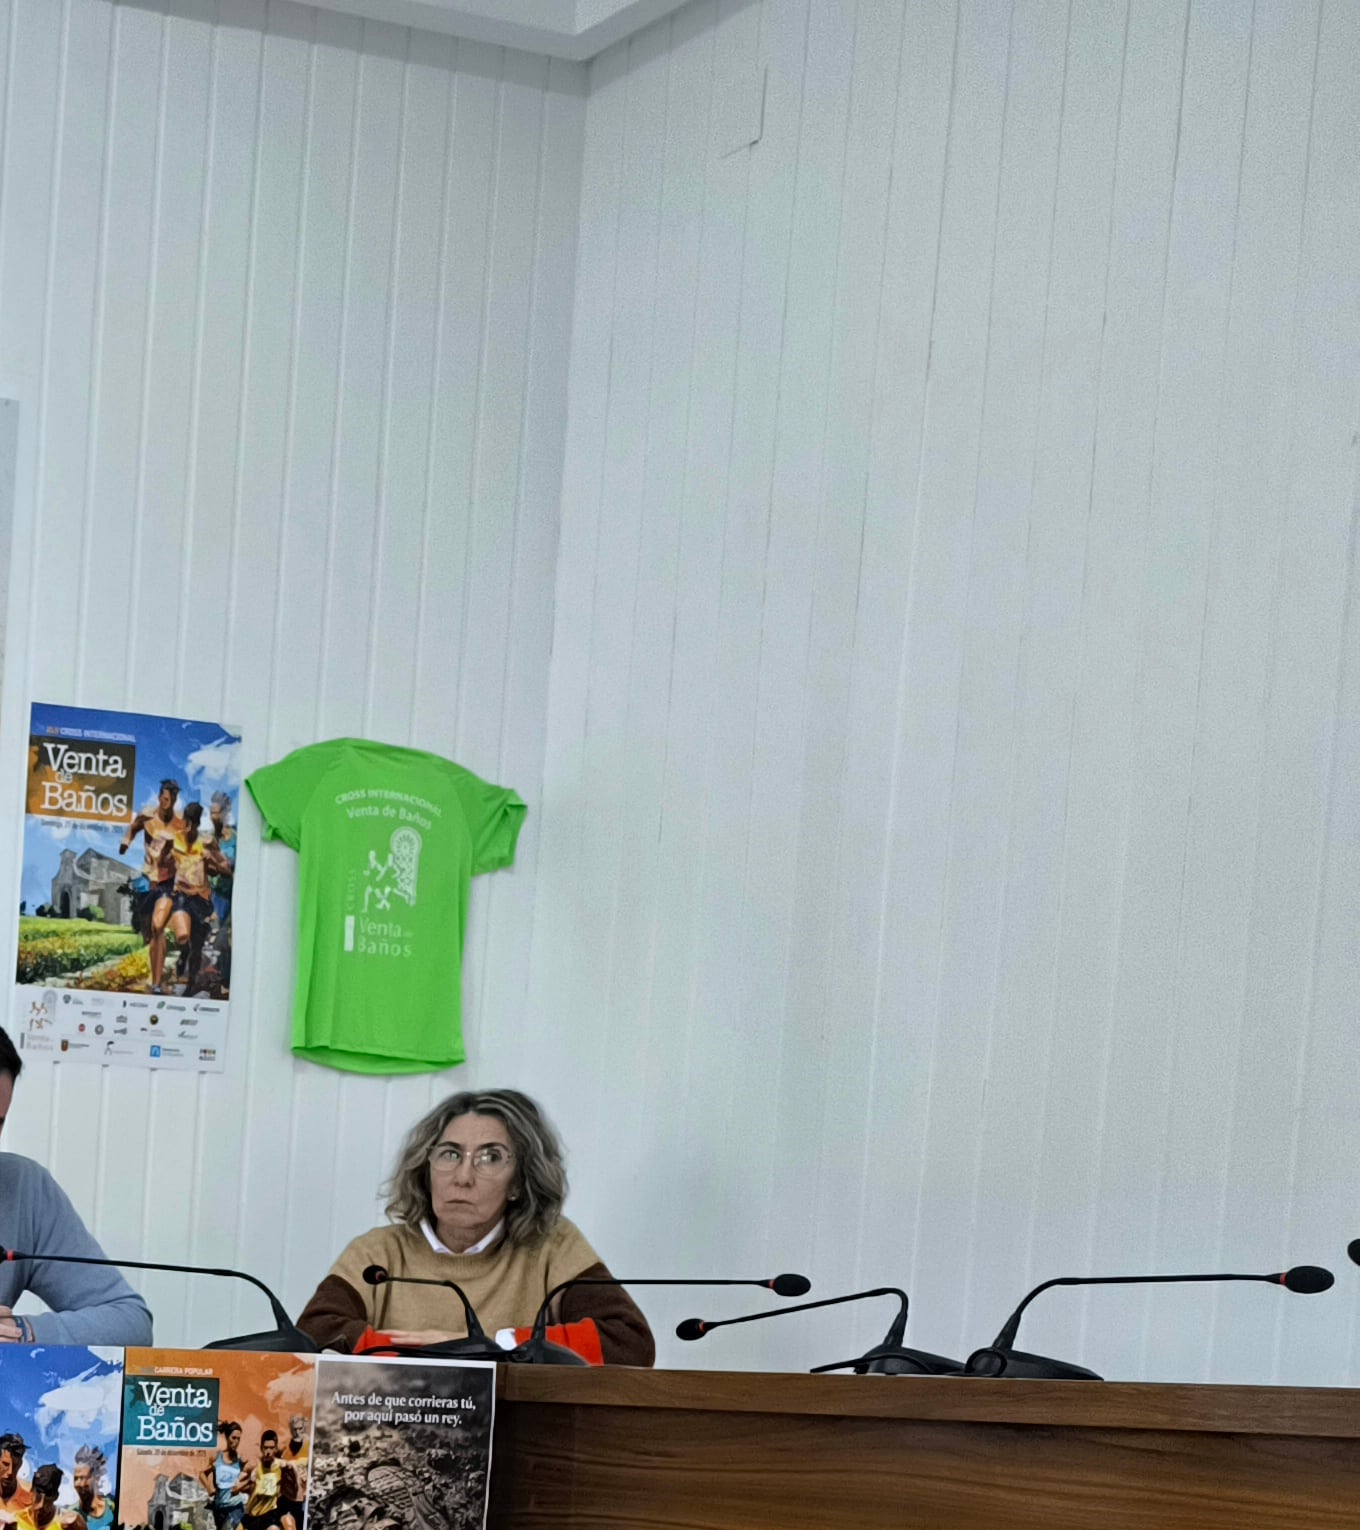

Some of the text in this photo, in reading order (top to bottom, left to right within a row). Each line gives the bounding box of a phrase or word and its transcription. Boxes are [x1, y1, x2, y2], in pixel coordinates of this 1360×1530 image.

[43, 742, 127, 778] Venta
[55, 768, 73, 783] de
[40, 781, 128, 817] Baños
[335, 789, 442, 817] CROSS INTERNACIONAL
[346, 805, 432, 830] Venta de Baños
[360, 917, 402, 937] Venta
[358, 935, 412, 958] Baños
[138, 1381, 212, 1409] Venta
[332, 1391, 476, 1411] Antes de que corrieras tú,
[149, 1403, 165, 1416] de
[344, 1409, 462, 1428] por aquí pasó un rey.
[136, 1415, 213, 1442] Baños
